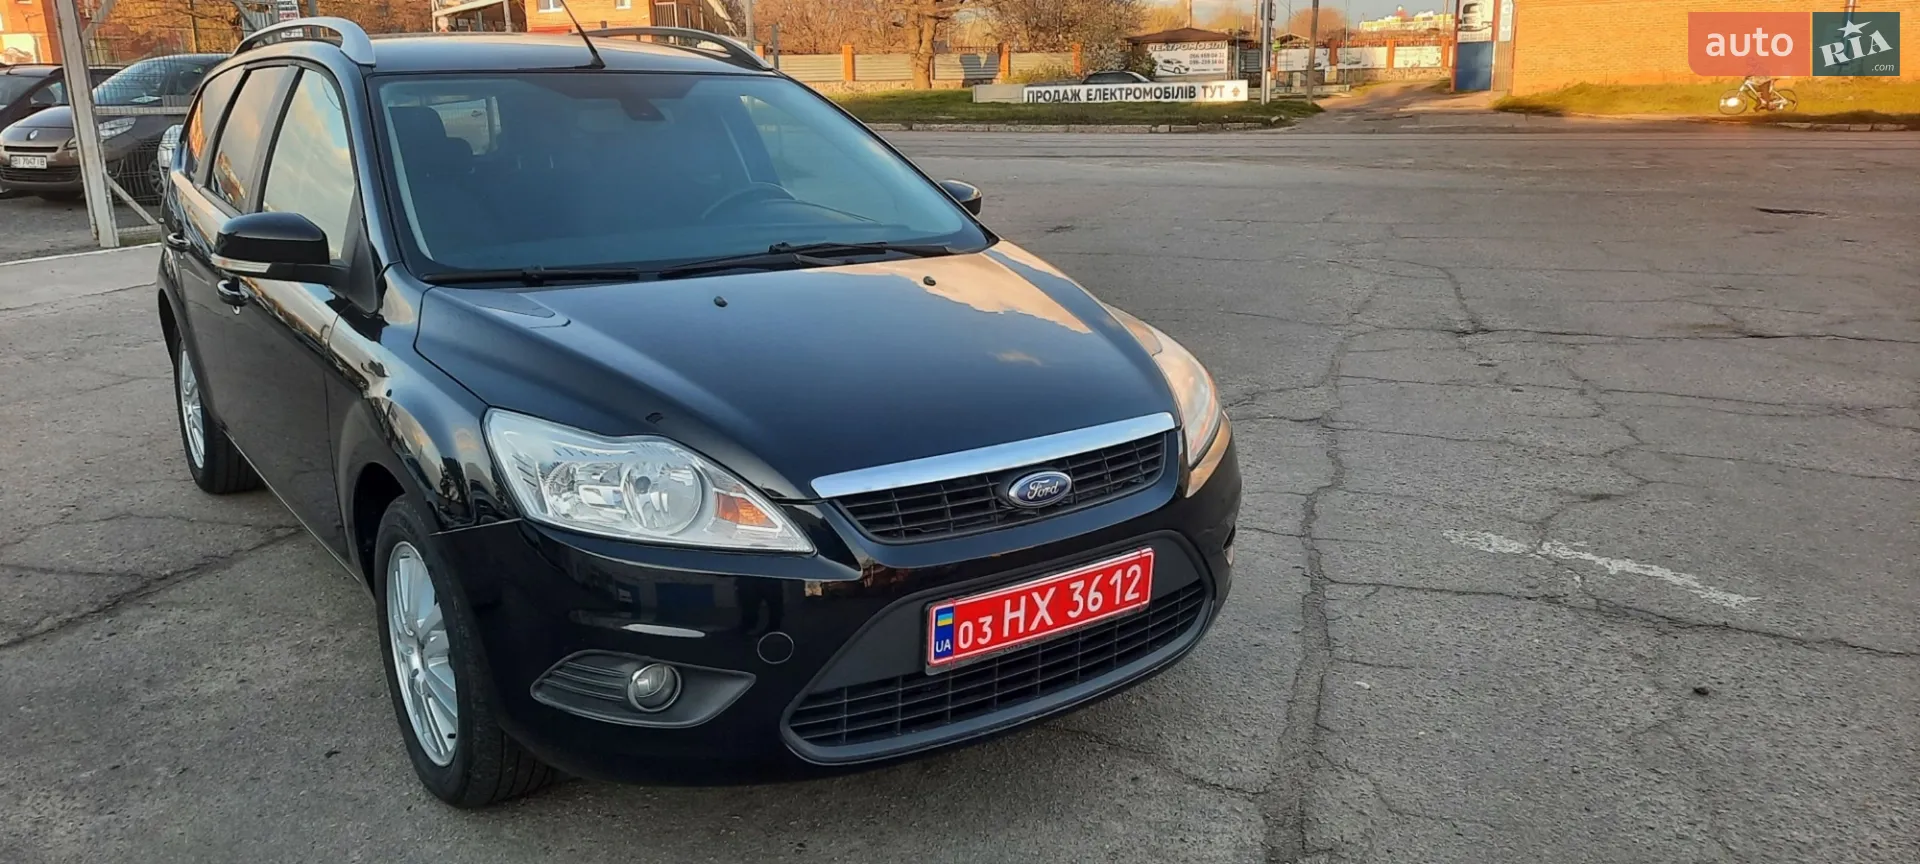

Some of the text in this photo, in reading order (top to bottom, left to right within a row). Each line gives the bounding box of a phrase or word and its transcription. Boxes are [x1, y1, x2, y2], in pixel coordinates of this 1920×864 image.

[1147, 41, 1227, 51] ЛЕКТРОМОБІЛІ
[1027, 85, 1225, 103] ПРОДАЖ ЕЛЕКТРОМОБІЛІВ ТУТ
[1027, 479, 1060, 500] Ford
[958, 564, 1142, 649] 03 HX 3612
[935, 638, 951, 653] UA
